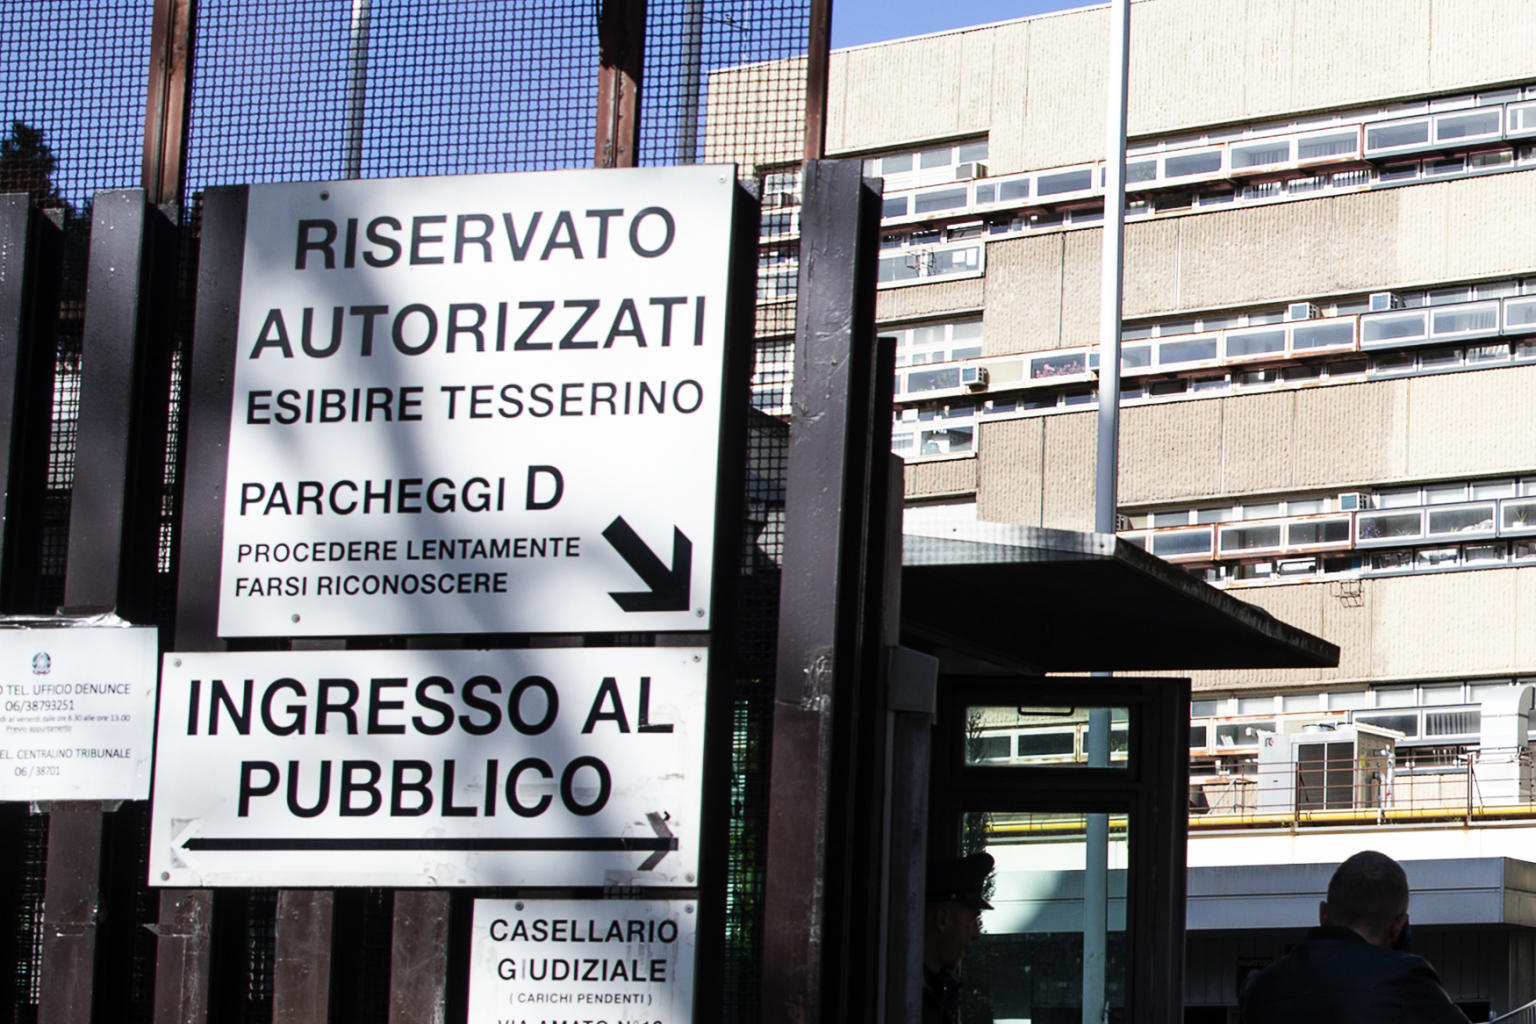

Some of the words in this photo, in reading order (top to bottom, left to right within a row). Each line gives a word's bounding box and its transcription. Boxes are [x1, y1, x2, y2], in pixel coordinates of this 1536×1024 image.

[295, 206, 676, 270] RISERVATO
[249, 296, 706, 360] AUTORIZZATI
[246, 386, 424, 425] ESIBIRE
[440, 379, 704, 420] TESSERINO
[239, 477, 505, 516] PARCHEGGI
[525, 464, 566, 511] D
[237, 540, 398, 563] PROCEDERE
[406, 536, 581, 561] LENTAMENTE
[235, 577, 308, 597] FARSI
[316, 572, 509, 596] RICONOSCERE
[75, 683, 131, 695] DENUNCE
[186, 675, 560, 736] INGRESSO
[581, 676, 675, 734] AL
[75, 748, 131, 759] TRIBUNALE
[237, 756, 613, 818] PUBBLICO
[489, 918, 679, 944] CASELLARIO
[497, 958, 668, 983] GIUDIZIALE
